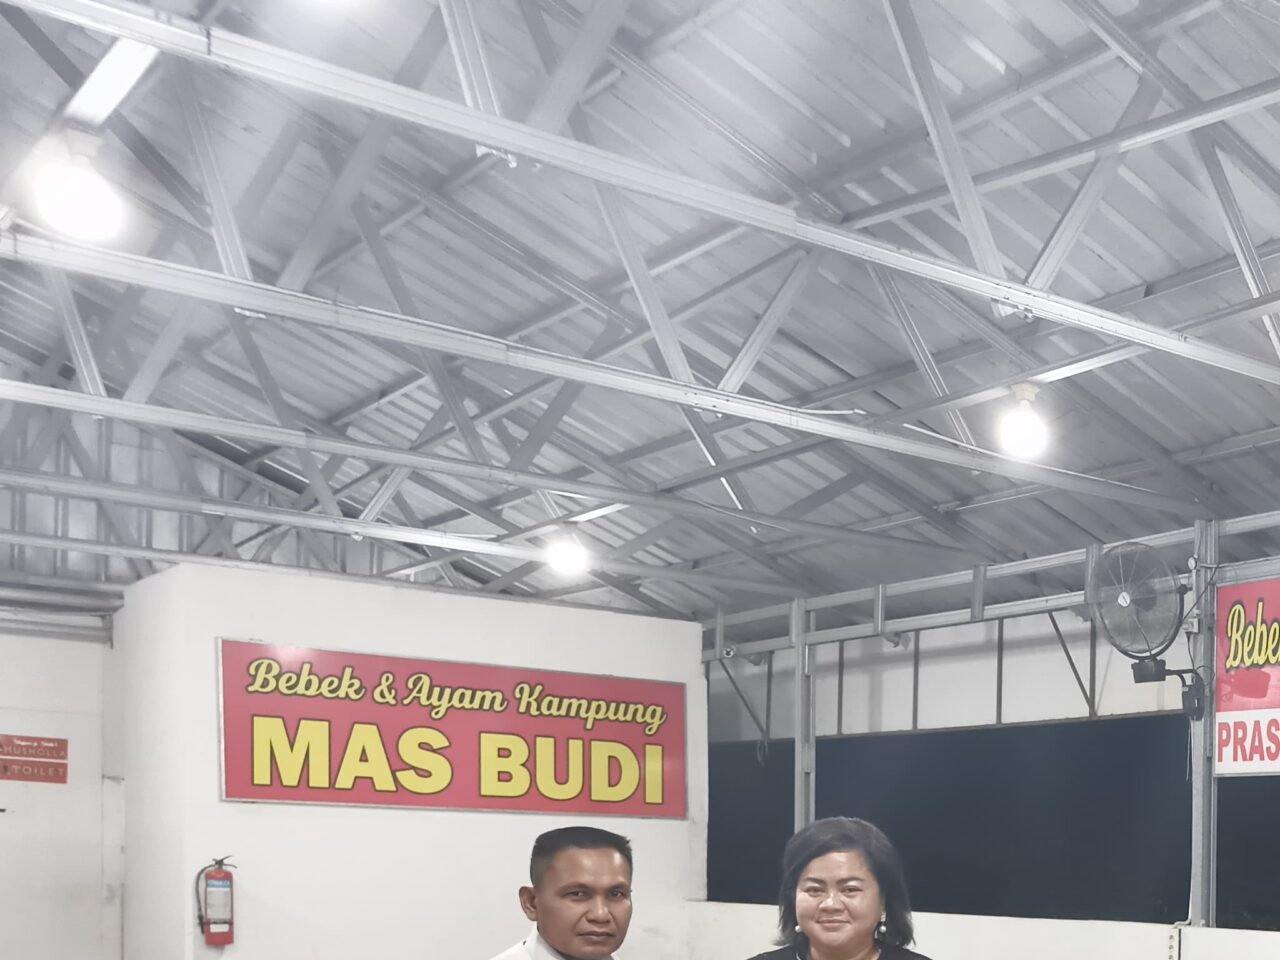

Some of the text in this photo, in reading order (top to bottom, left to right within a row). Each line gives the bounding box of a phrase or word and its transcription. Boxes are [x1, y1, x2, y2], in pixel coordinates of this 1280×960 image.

[247, 658, 667, 736] Bebek & Ayam Kampung
[251, 714, 664, 805] MAS BUDI
